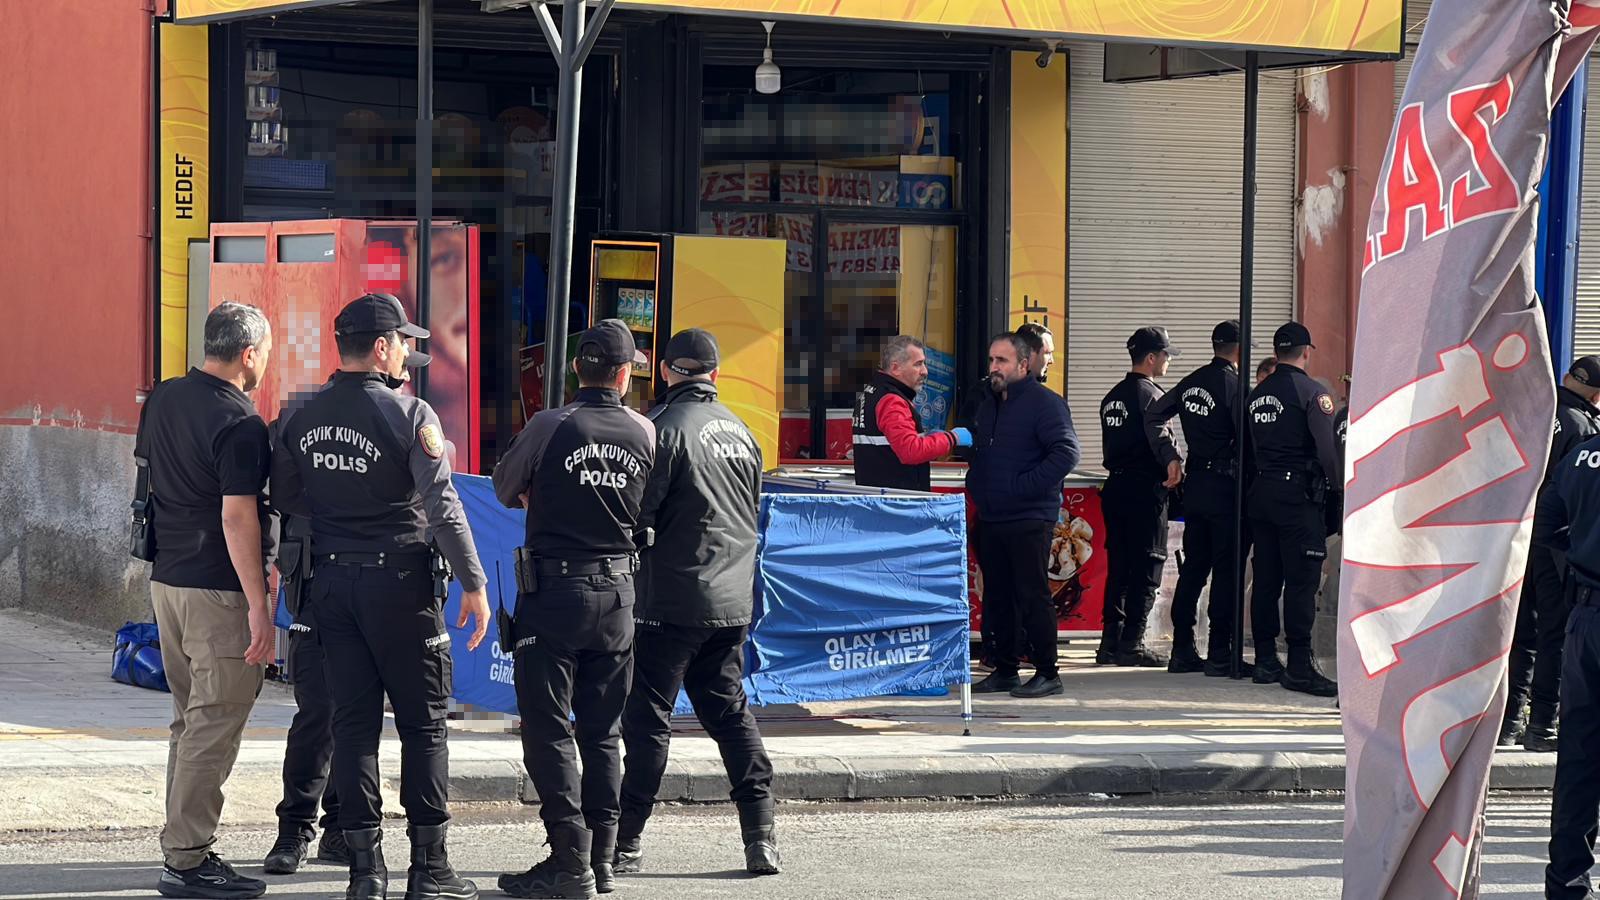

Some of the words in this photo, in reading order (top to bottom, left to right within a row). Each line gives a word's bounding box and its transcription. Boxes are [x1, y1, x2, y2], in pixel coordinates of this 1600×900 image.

[175, 152, 193, 220] HEDEF
[335, 426, 382, 463] KUVVET
[600, 443, 642, 478] KUVVET
[824, 632, 877, 655] OLAY
